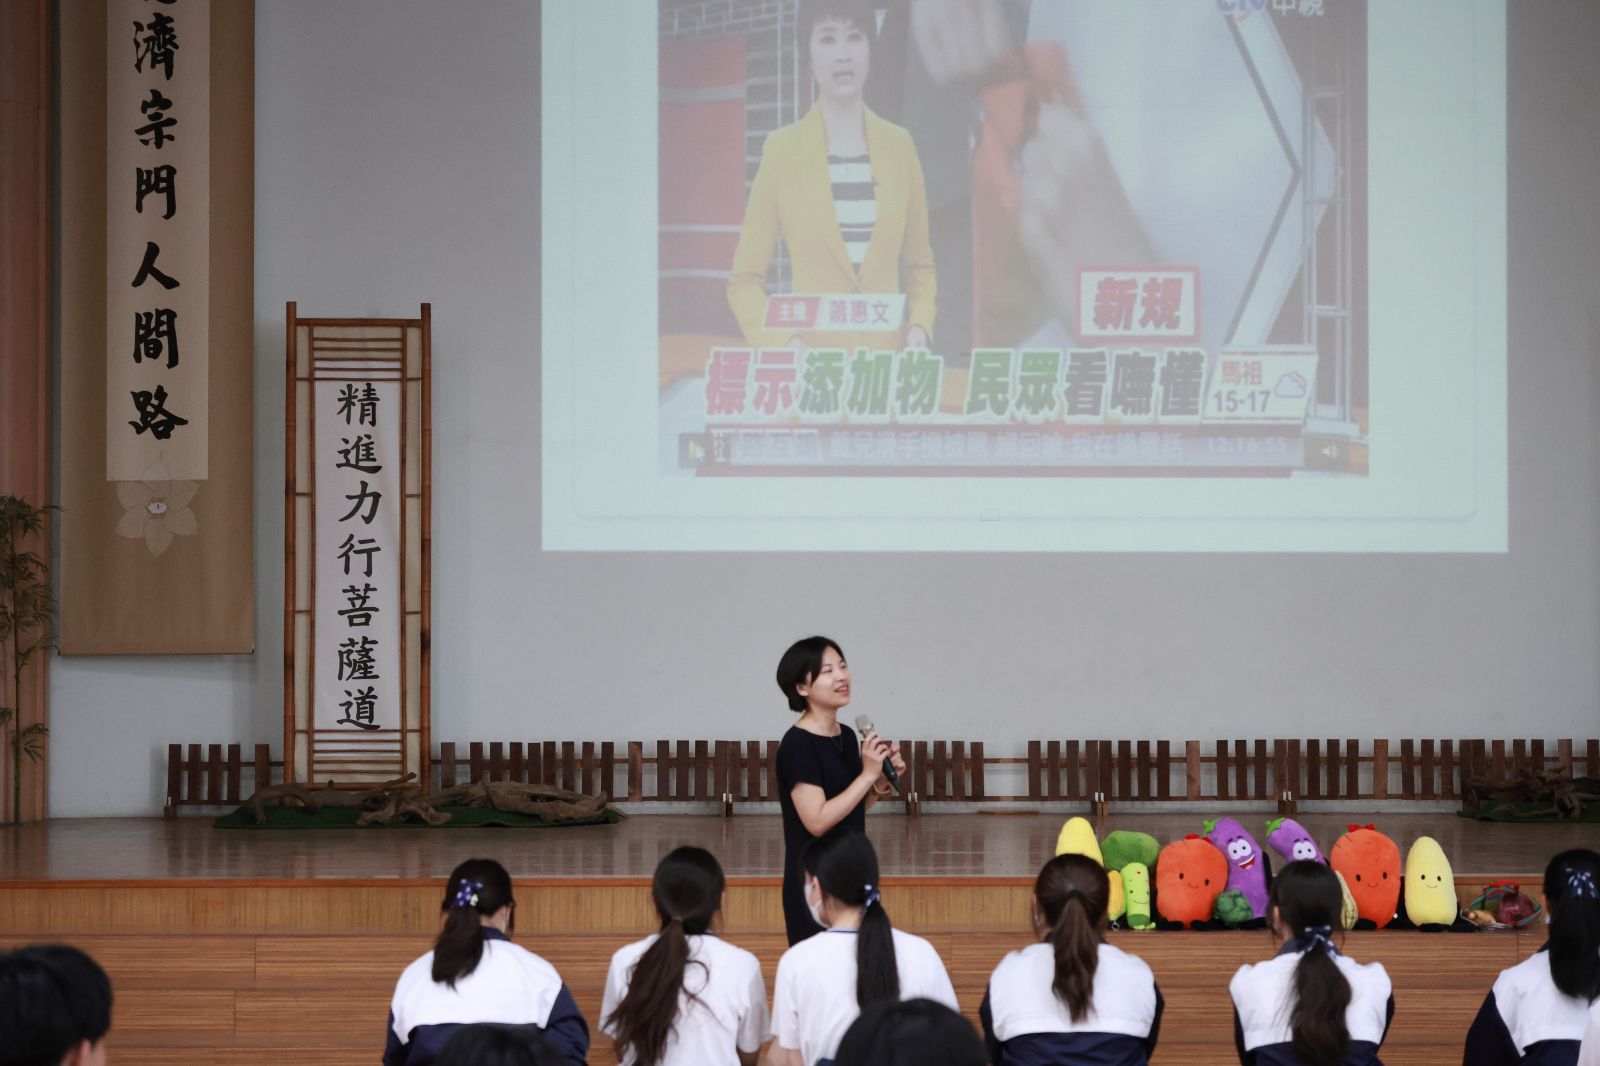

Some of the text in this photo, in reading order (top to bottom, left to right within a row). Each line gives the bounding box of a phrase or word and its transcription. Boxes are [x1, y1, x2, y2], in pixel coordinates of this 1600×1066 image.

[128, 0, 189, 440] 濟宗門人間路
[1094, 277, 1184, 330] 新規
[705, 348, 944, 416] 標示添加物
[1213, 389, 1271, 413] 15-17
[335, 382, 383, 731] 精進力行菩薩道
